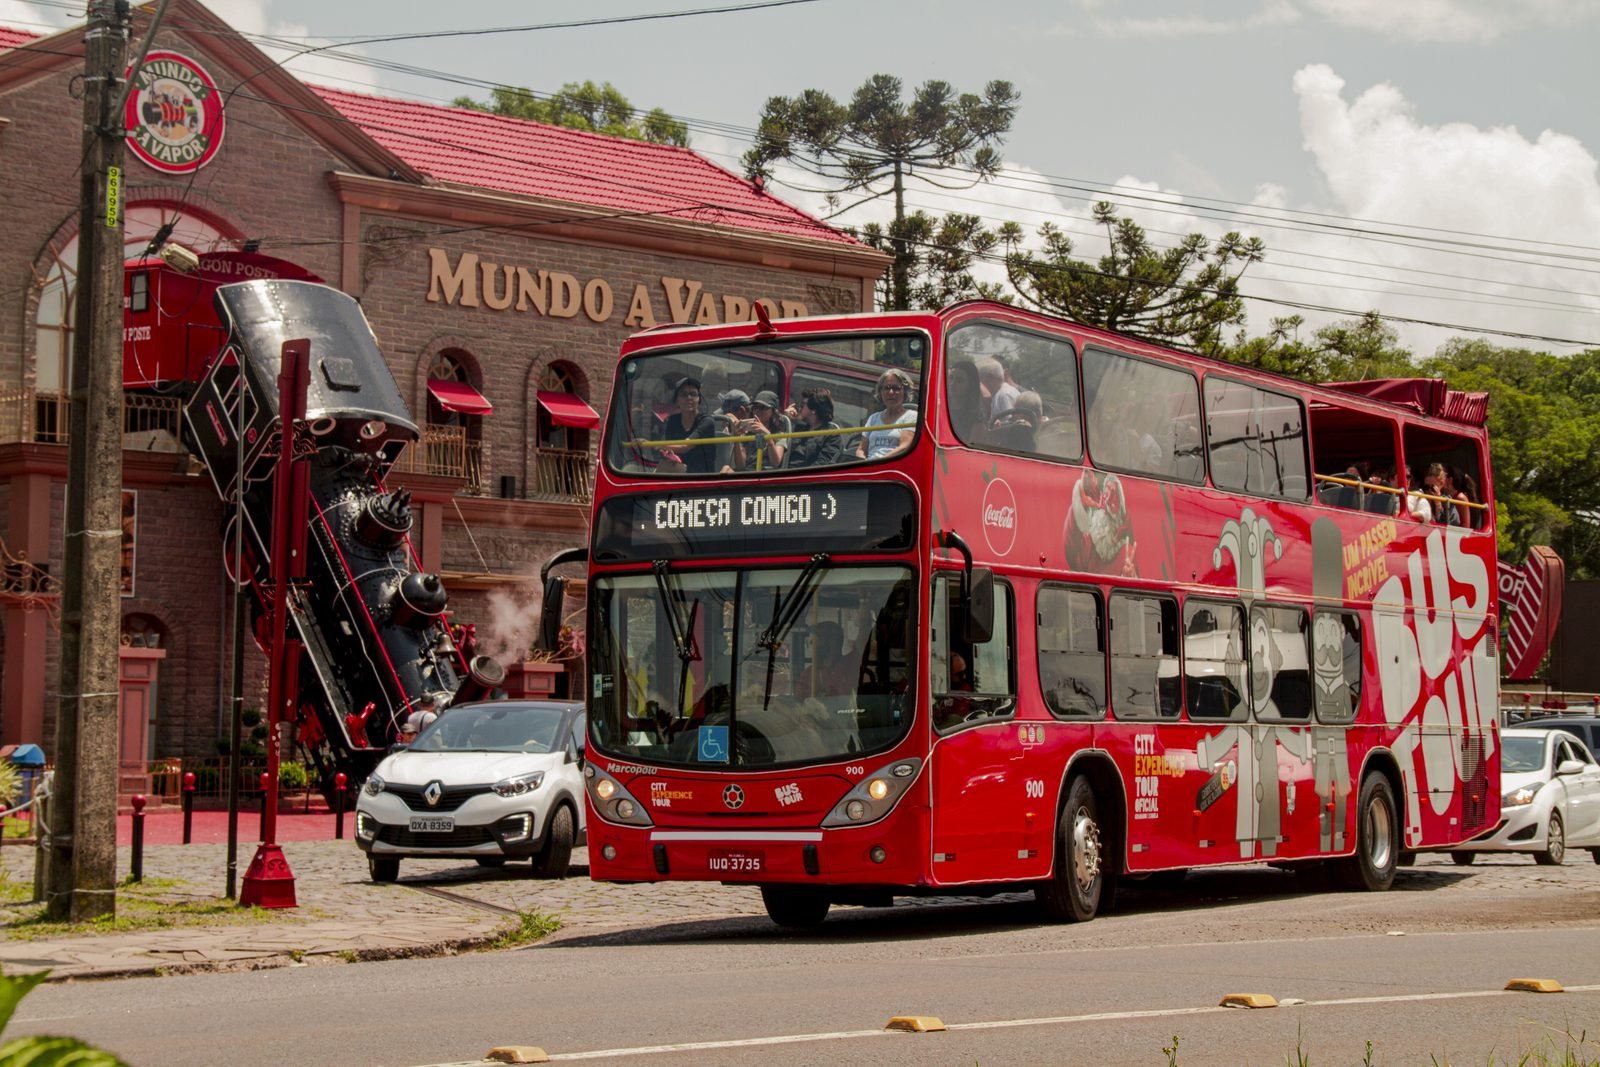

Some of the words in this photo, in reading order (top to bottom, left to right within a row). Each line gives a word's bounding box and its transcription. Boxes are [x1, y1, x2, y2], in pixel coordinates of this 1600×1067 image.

[138, 62, 203, 92] MUNDO
[137, 132, 151, 147] A
[151, 140, 204, 162] VAPOR
[109, 168, 118, 226] 963959
[197, 259, 232, 274] GON
[427, 248, 613, 322] MUNDO
[624, 284, 656, 328] A
[655, 498, 730, 529] COMEÇA
[741, 494, 811, 526] COMIGO
[1343, 540, 1360, 571] UM
[1135, 734, 1155, 755] CITY
[607, 763, 658, 776] Marcopolo
[845, 766, 864, 776] 900
[1135, 755, 1186, 776] EXPERIENCE
[651, 782, 667, 792] CITY
[651, 791, 693, 799] EXPERIENCE
[775, 782, 800, 800] BUS
[1026, 780, 1044, 798] 900
[1135, 776, 1158, 797] TOUR
[652, 799, 671, 807] TOUR
[778, 792, 803, 807] TOUR
[1135, 798, 1158, 812] OFICIAL
